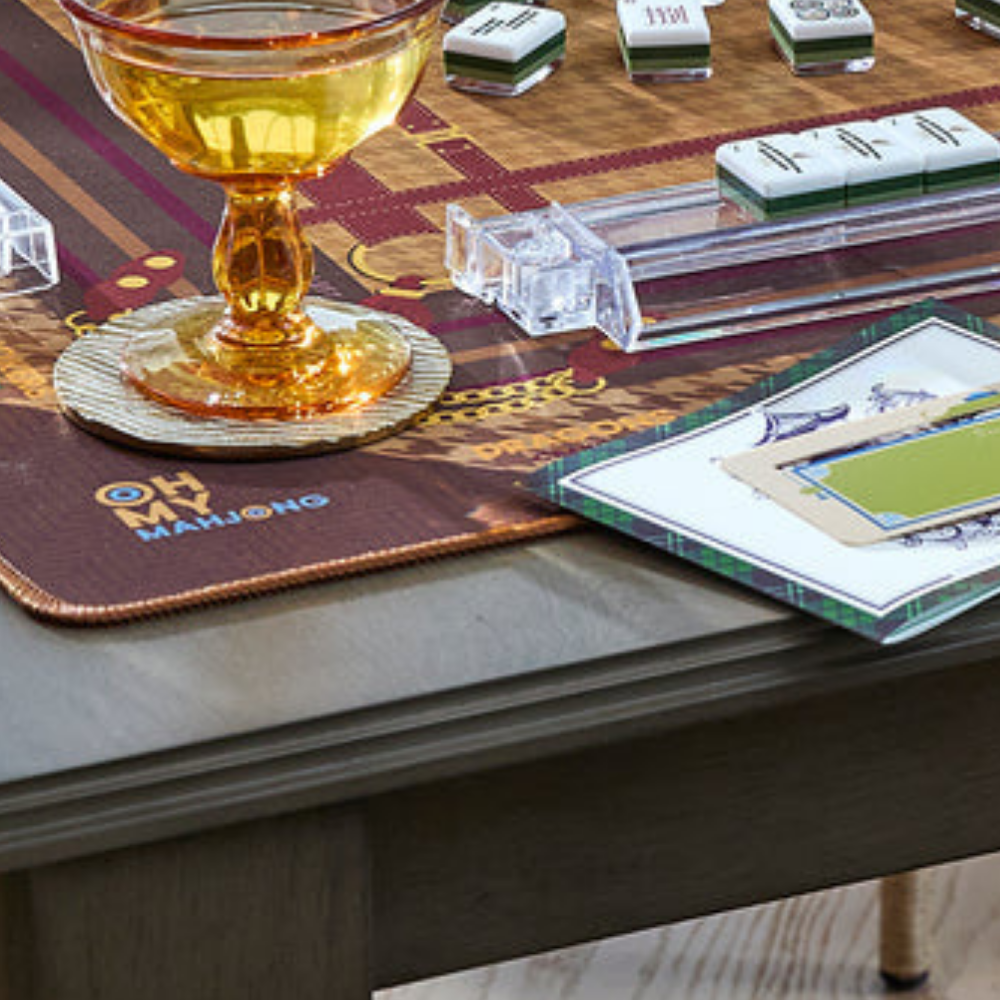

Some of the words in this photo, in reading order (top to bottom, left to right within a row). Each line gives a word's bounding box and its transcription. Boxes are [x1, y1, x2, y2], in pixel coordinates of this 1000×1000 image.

[95, 470, 206, 508] OH
[112, 490, 212, 529] MY
[134, 493, 330, 542] MAHJONG
